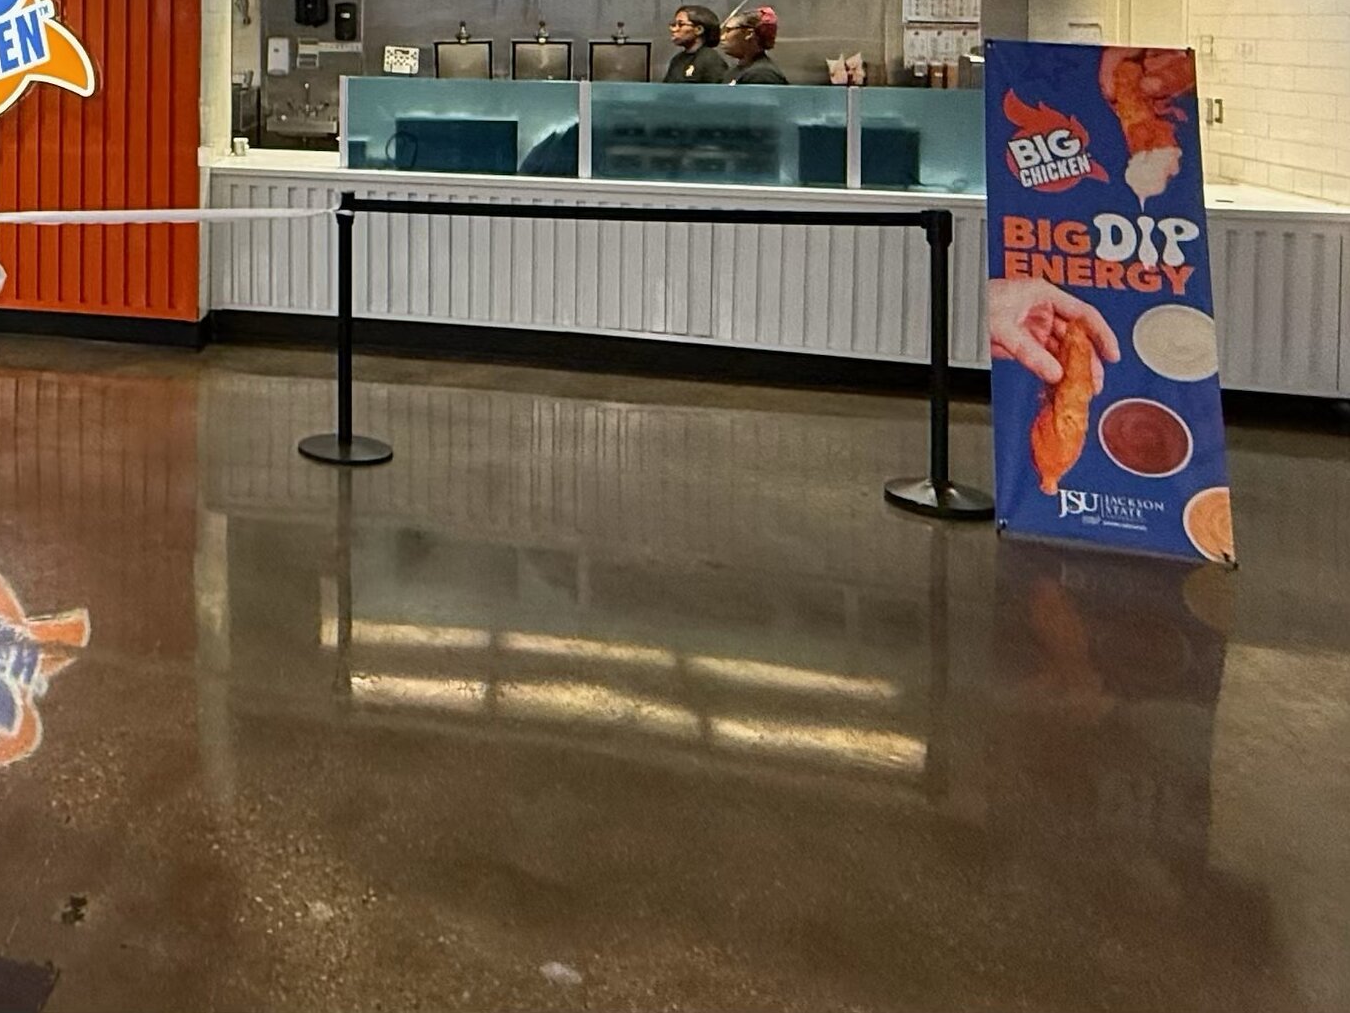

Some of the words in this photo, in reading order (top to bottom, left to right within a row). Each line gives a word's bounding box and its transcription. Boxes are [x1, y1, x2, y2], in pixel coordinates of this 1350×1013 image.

[1008, 129, 1081, 169] BIG
[1019, 153, 1091, 188] CHICKEN
[1003, 215, 1091, 255] BIG
[1093, 213, 1199, 268] DIP
[1004, 251, 1195, 296] ENERGY
[1058, 489, 1099, 518] JSU
[1105, 494, 1164, 512] JACKSON
